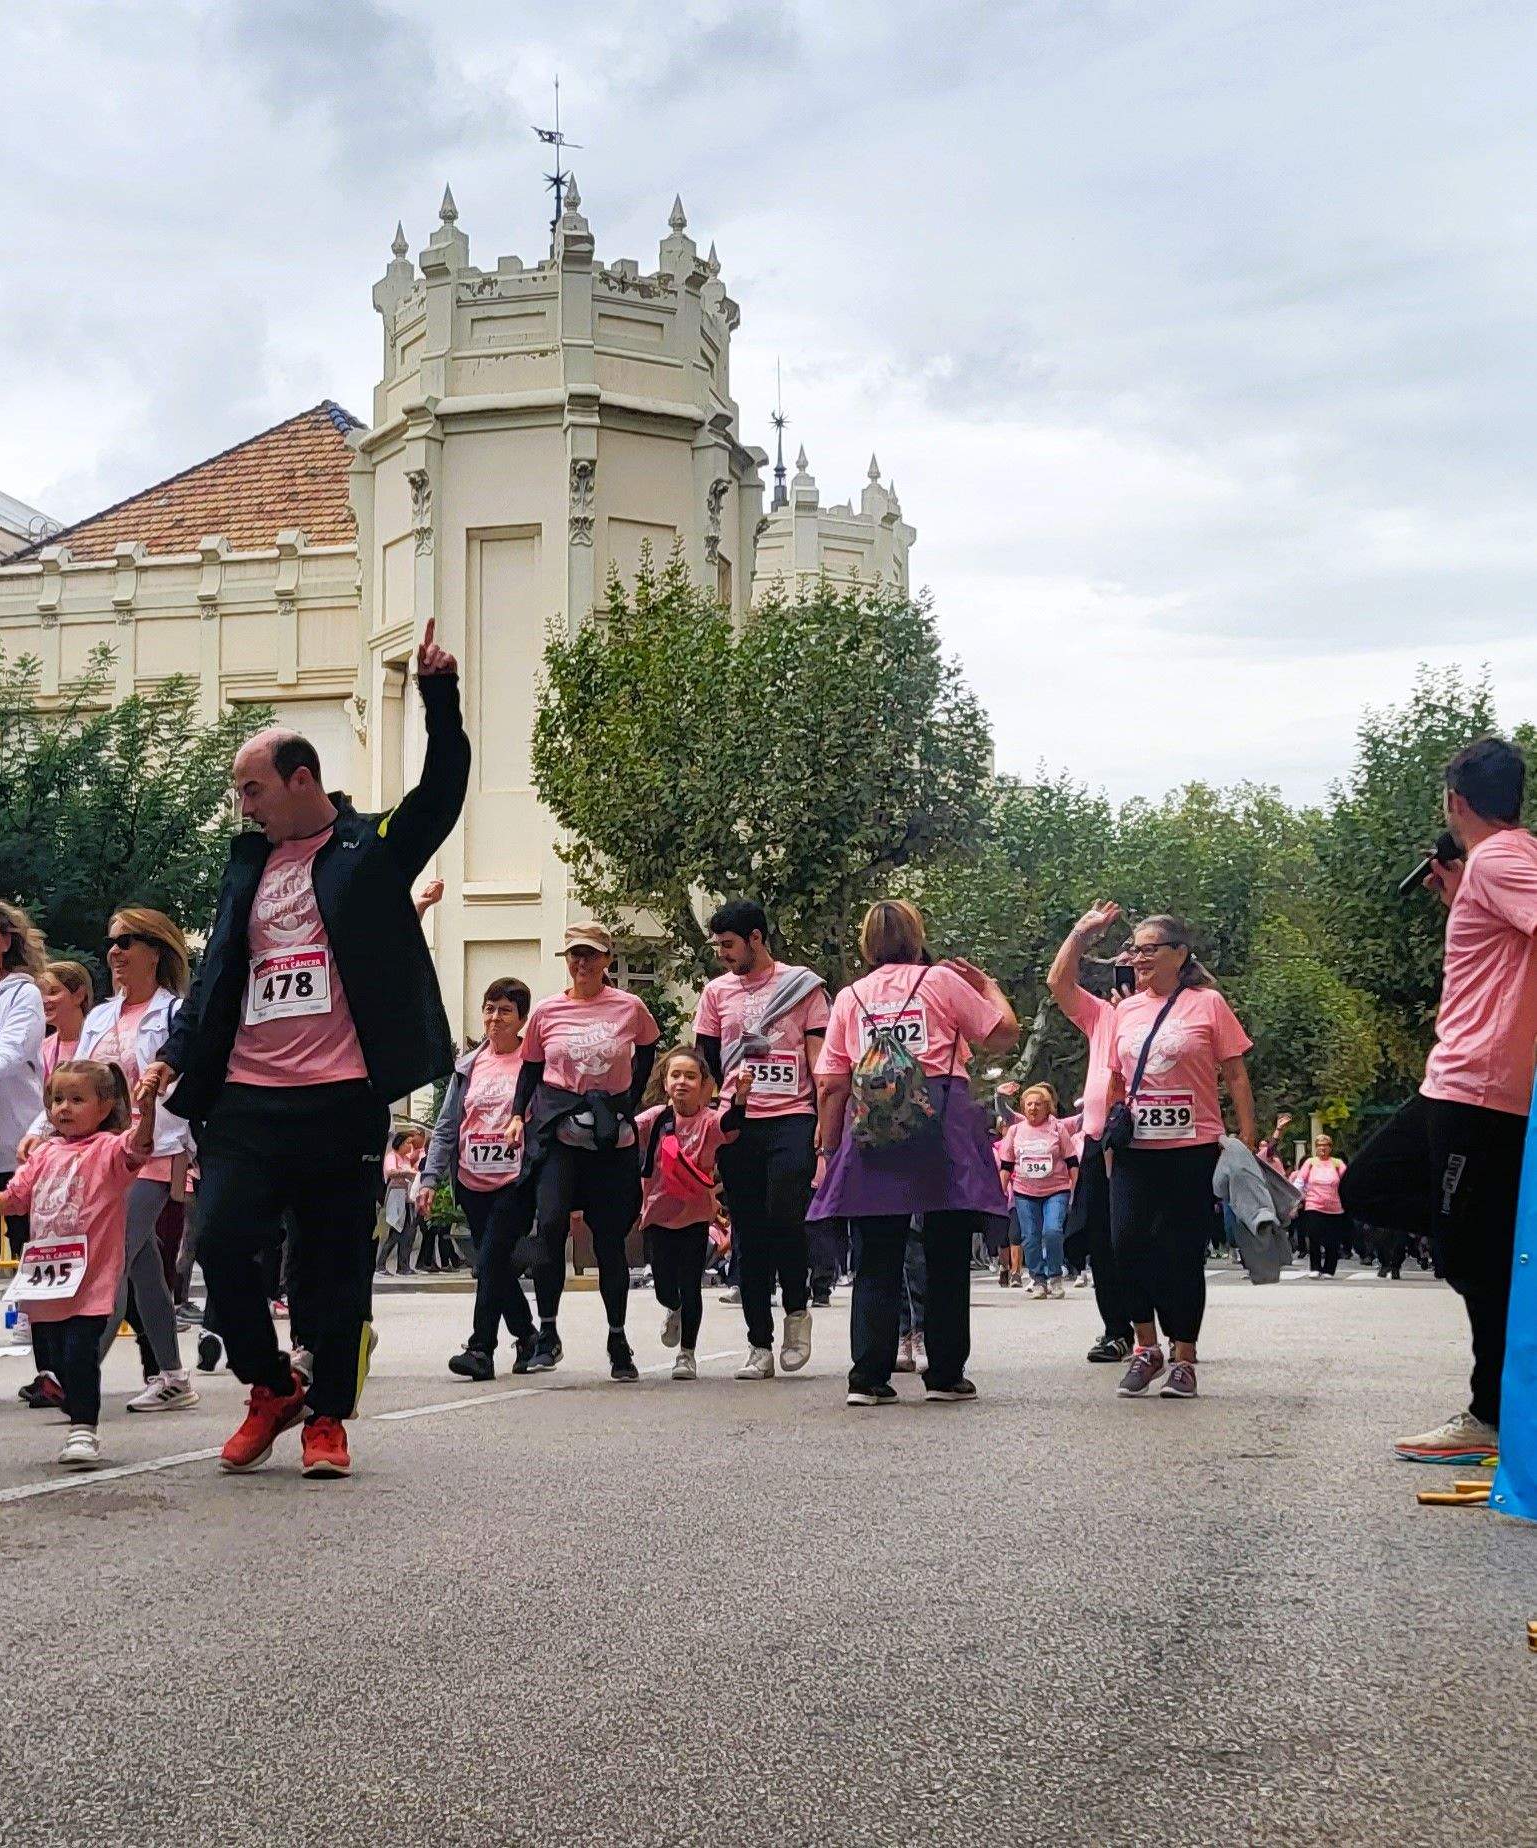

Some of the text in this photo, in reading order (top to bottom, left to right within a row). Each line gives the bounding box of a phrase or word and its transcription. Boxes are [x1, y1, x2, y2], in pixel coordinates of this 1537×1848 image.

[262, 972, 313, 1002] 478
[1138, 1107, 1191, 1127] 2839
[471, 1145, 516, 1162] 1724
[27, 1262, 72, 1287] 415
